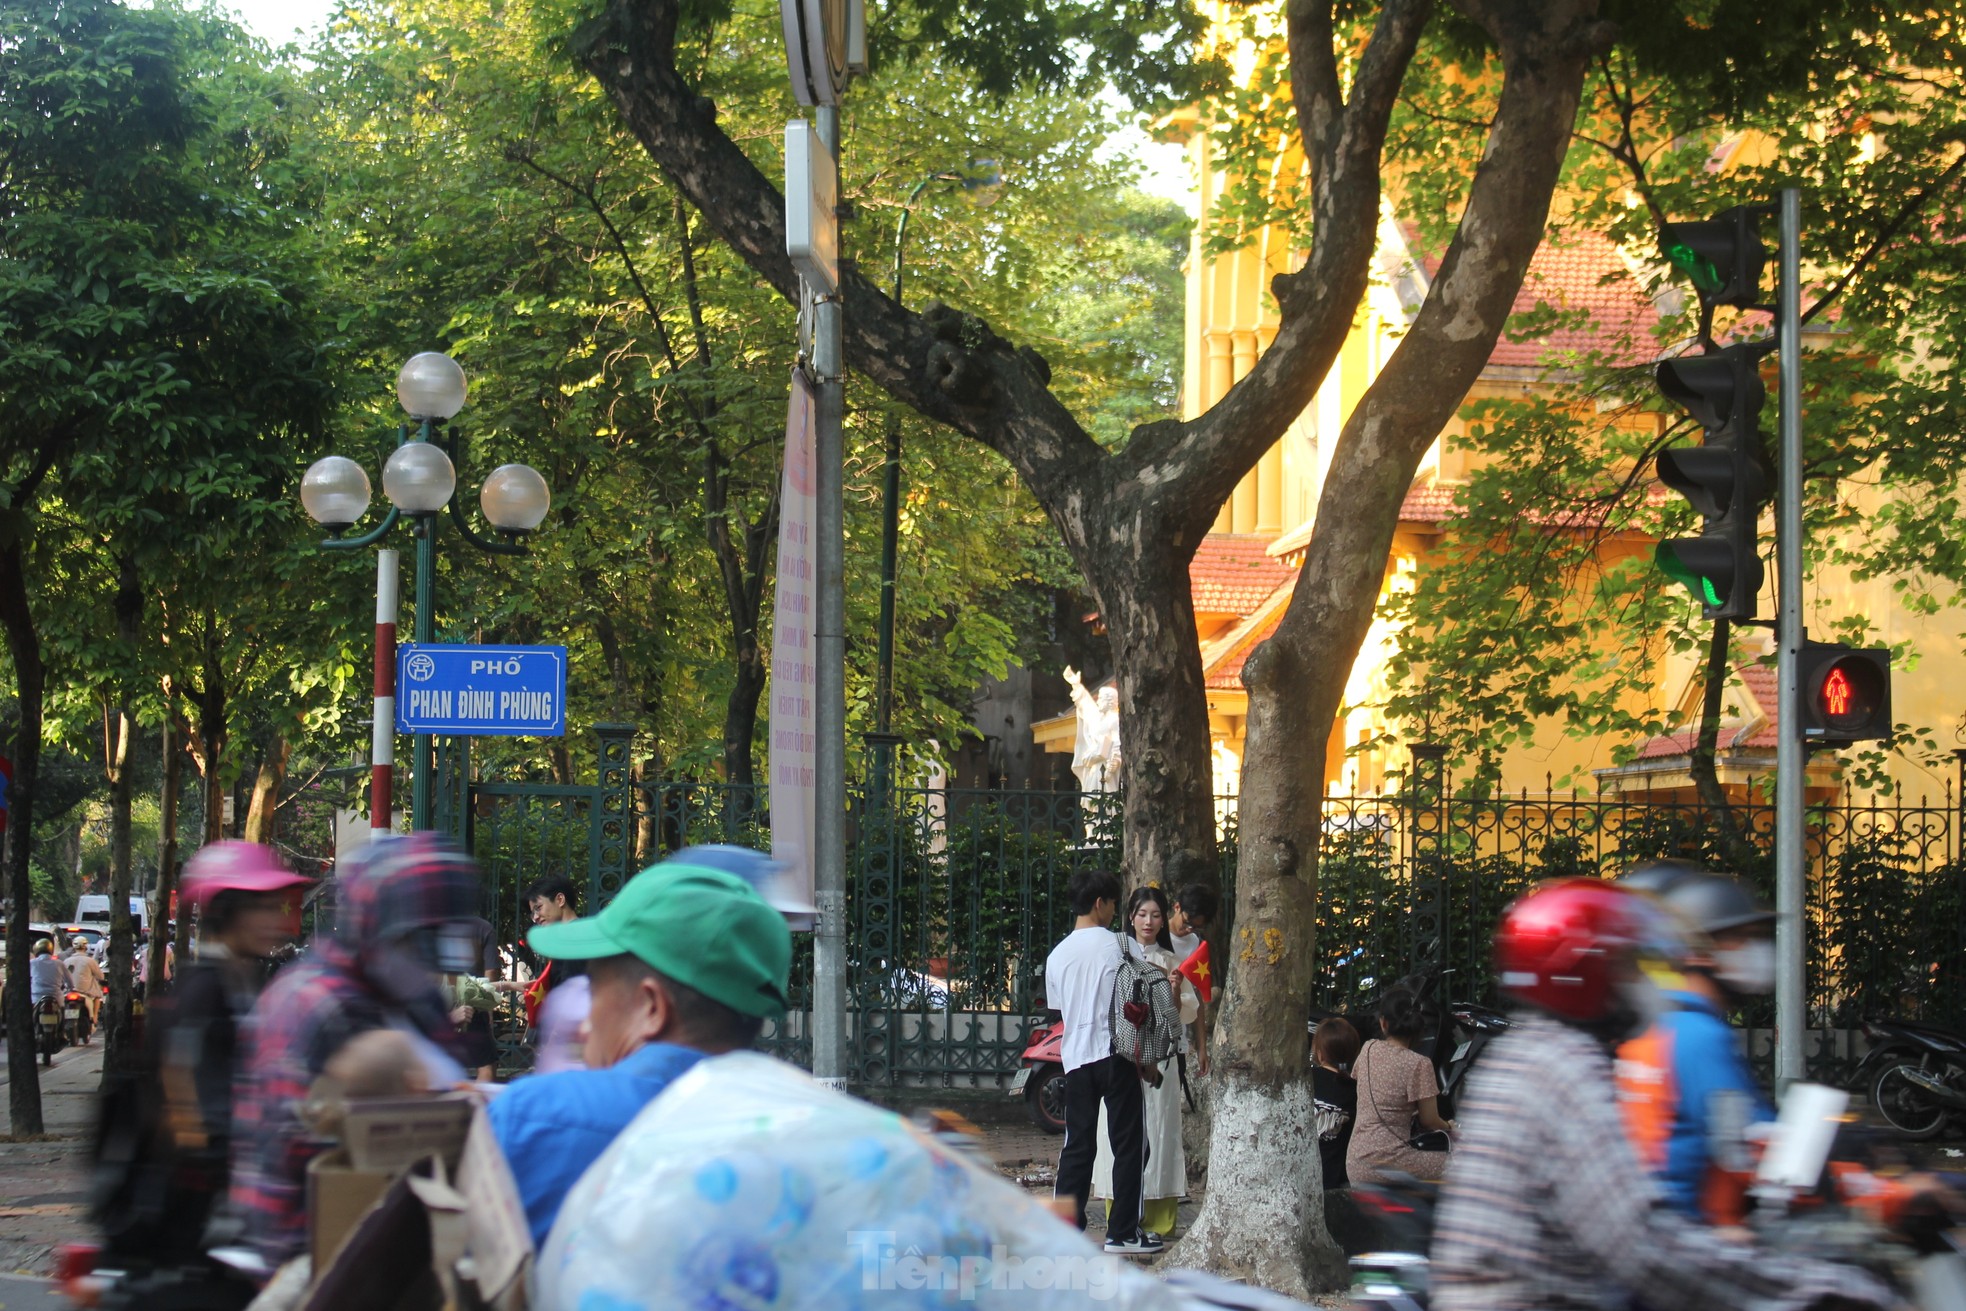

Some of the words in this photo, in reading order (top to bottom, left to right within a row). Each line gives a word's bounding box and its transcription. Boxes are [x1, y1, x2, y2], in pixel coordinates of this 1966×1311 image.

[471, 655, 524, 675] PHỐ
[410, 690, 452, 719] PHAN
[458, 685, 494, 720] ĐÌNH
[500, 686, 552, 721] PHÙNG
